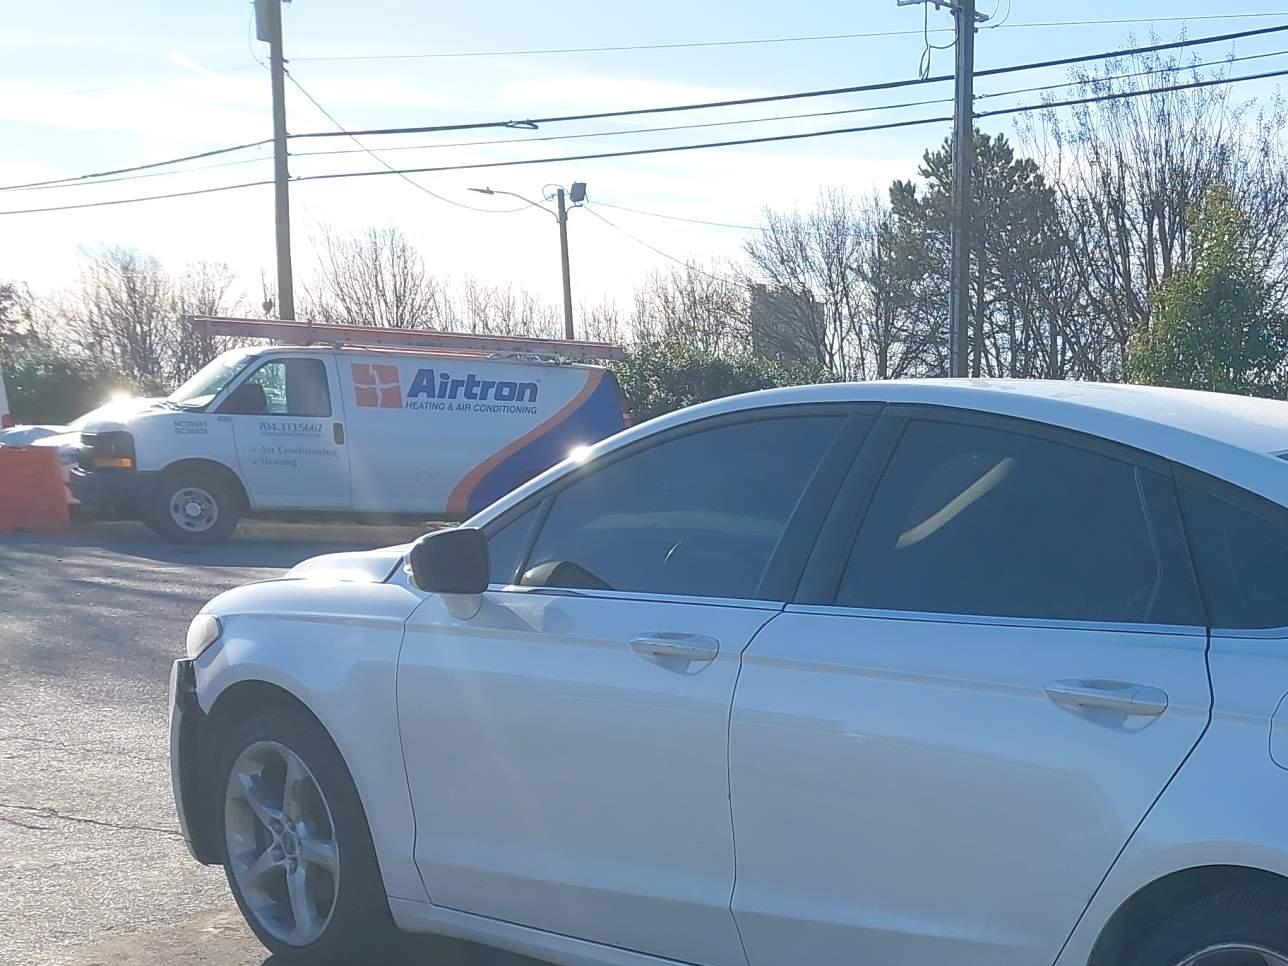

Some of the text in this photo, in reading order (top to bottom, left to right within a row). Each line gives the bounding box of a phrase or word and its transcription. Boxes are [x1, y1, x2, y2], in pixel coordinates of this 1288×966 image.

[407, 368, 539, 403] Airtron
[405, 401, 537, 415] HEATING & AIR CONDITIONING
